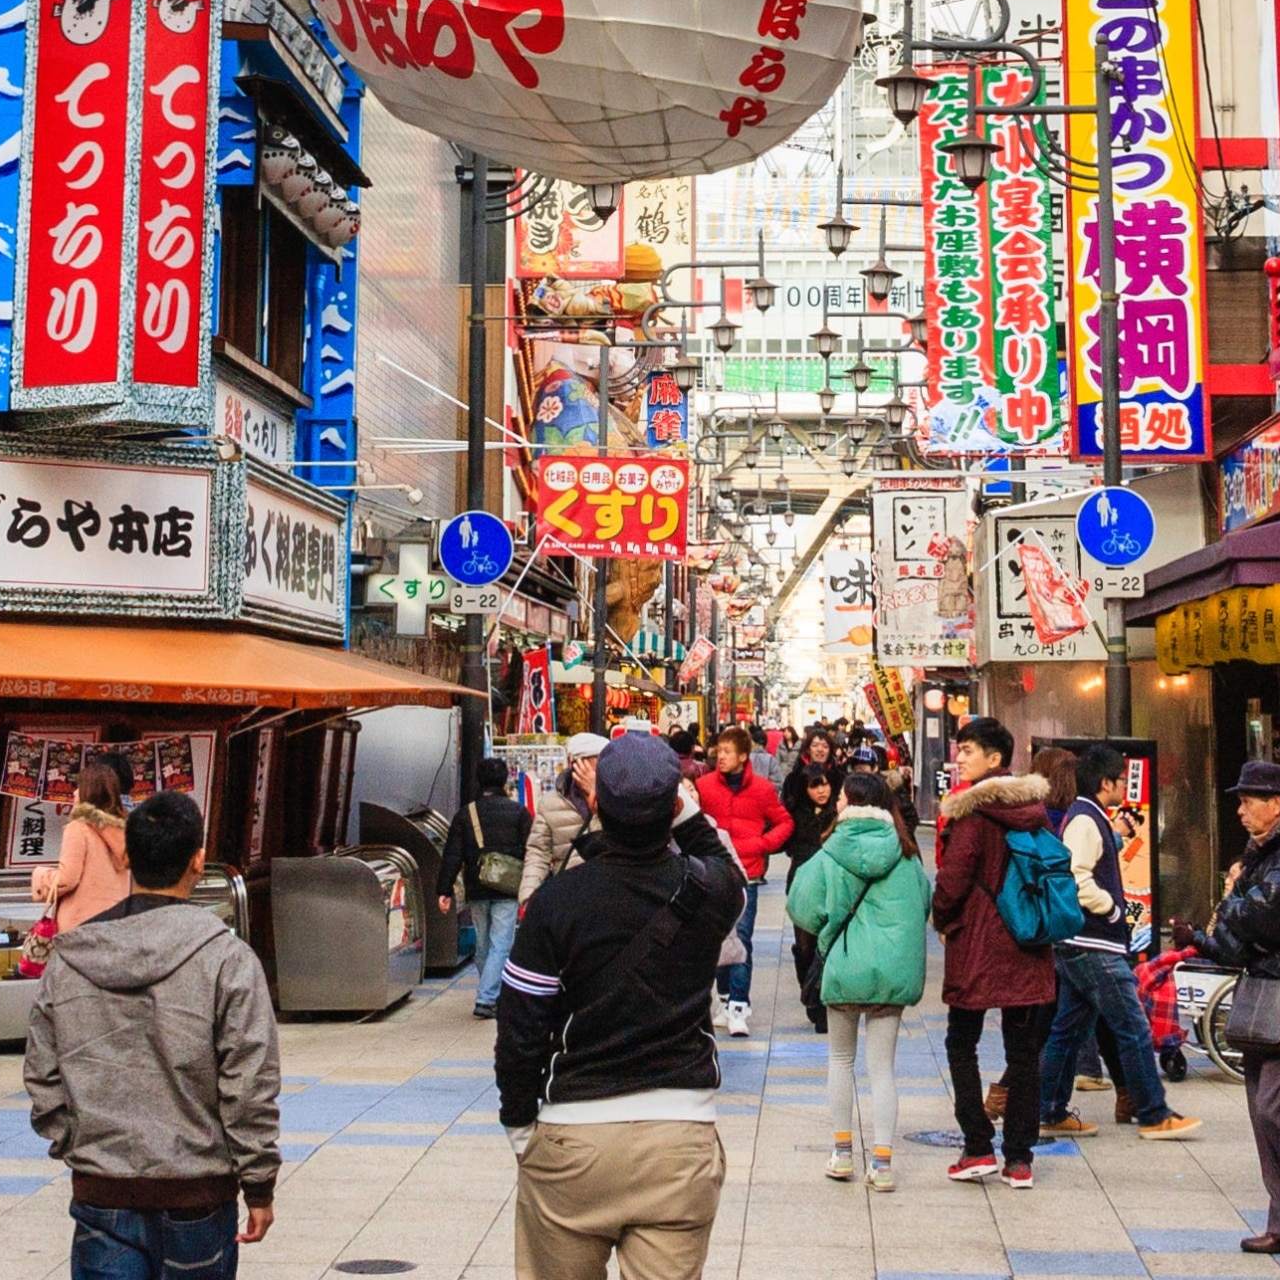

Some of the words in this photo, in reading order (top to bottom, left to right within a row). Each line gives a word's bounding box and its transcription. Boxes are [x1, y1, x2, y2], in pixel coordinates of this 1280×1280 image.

[46, 62, 111, 354] てっちり
[143, 63, 201, 355] てっちり
[992, 72, 1050, 442] 大小宴会承り中
[786, 285, 864, 308] 00周年
[1081, 201, 1192, 395] 横綱
[243, 407, 278, 459] てっちり
[650, 375, 684, 442] 麻雀
[1096, 408, 1187, 446] 酒処
[581, 472, 612, 485] 日用品
[618, 473, 647, 486] お菓子
[543, 489, 680, 543] くすり
[244, 500, 336, 604] ふぐ料理専門
[378, 577, 446, 600] くすり
[453, 594, 498, 609] 9-22
[1094, 576, 1141, 592] 9-22
